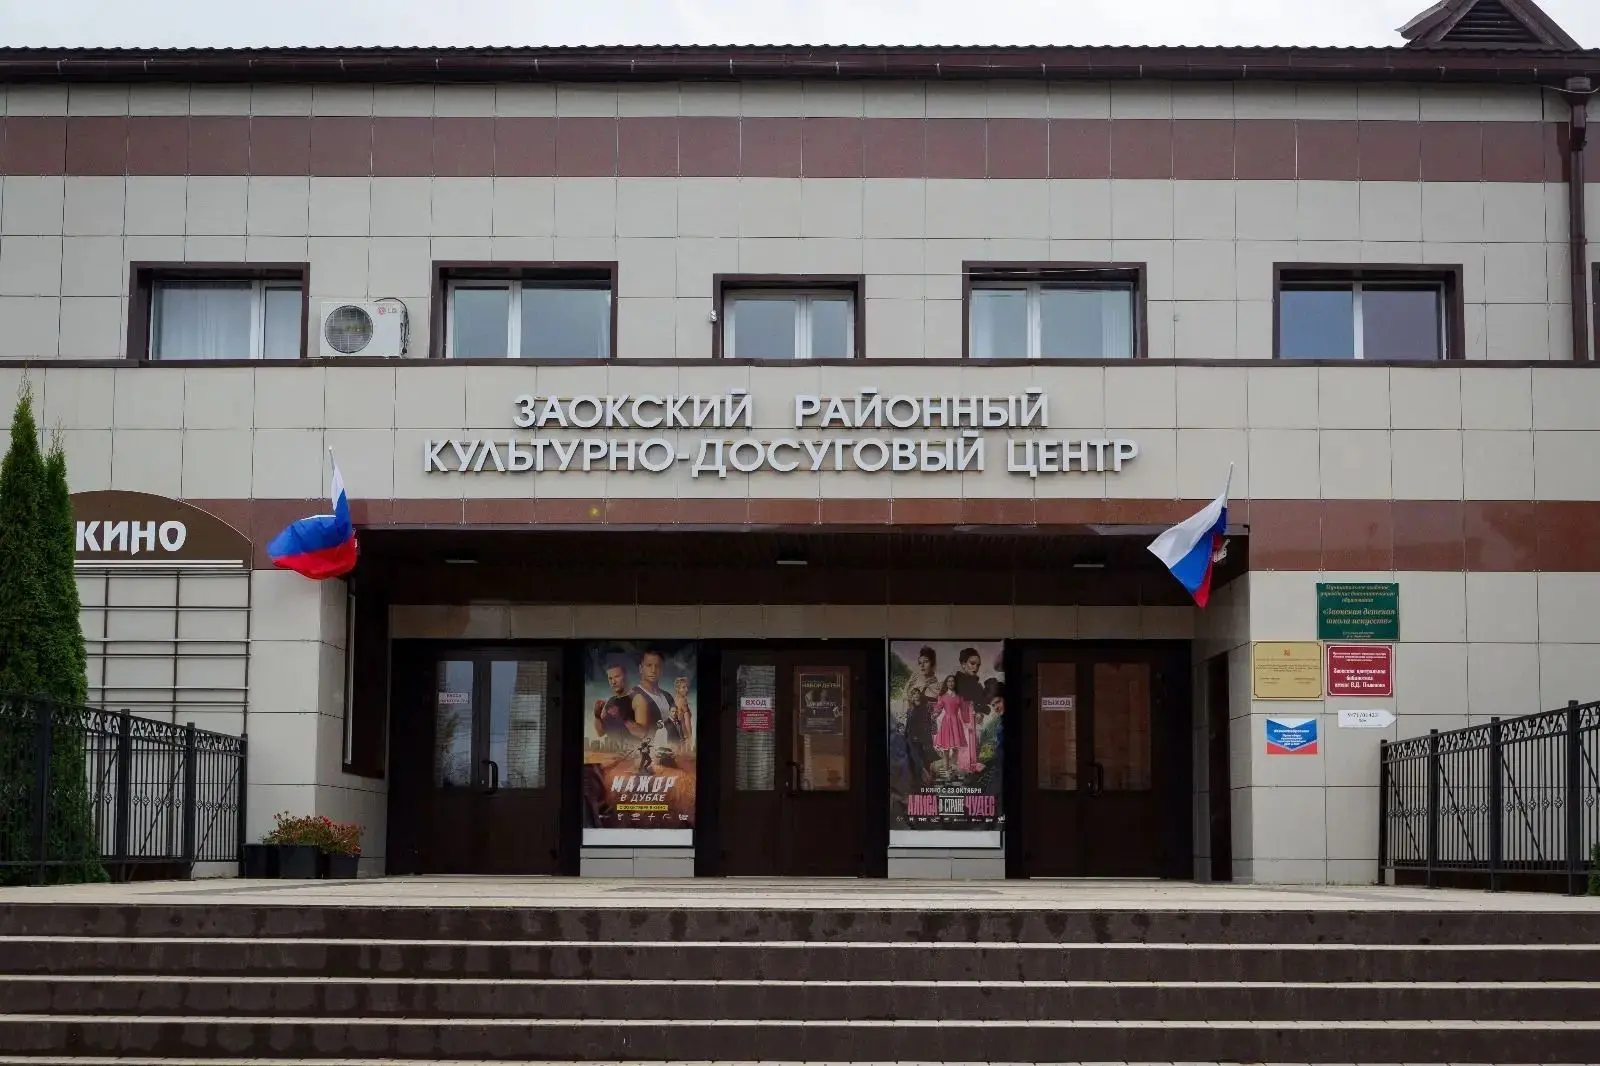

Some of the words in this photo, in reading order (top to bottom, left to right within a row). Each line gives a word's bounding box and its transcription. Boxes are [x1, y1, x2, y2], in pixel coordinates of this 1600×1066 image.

[512, 389, 753, 429] ЗАОКСКИЙ
[793, 386, 1050, 429] РАЙОННЫЙ
[423, 430, 986, 479] КУЛЬТУРНО-ДОСУГОВЫЙ
[1005, 438, 1140, 479] ЦЕНТР
[75, 520, 187, 556] КИНО
[1326, 617, 1351, 625] школа
[611, 775, 678, 793] МАЖОР
[630, 794, 666, 802] ДУБАЕ
[907, 794, 938, 816] АЛИСА
[944, 798, 965, 813] СТРАНЕ
[965, 795, 995, 816] ЧУДЕС
